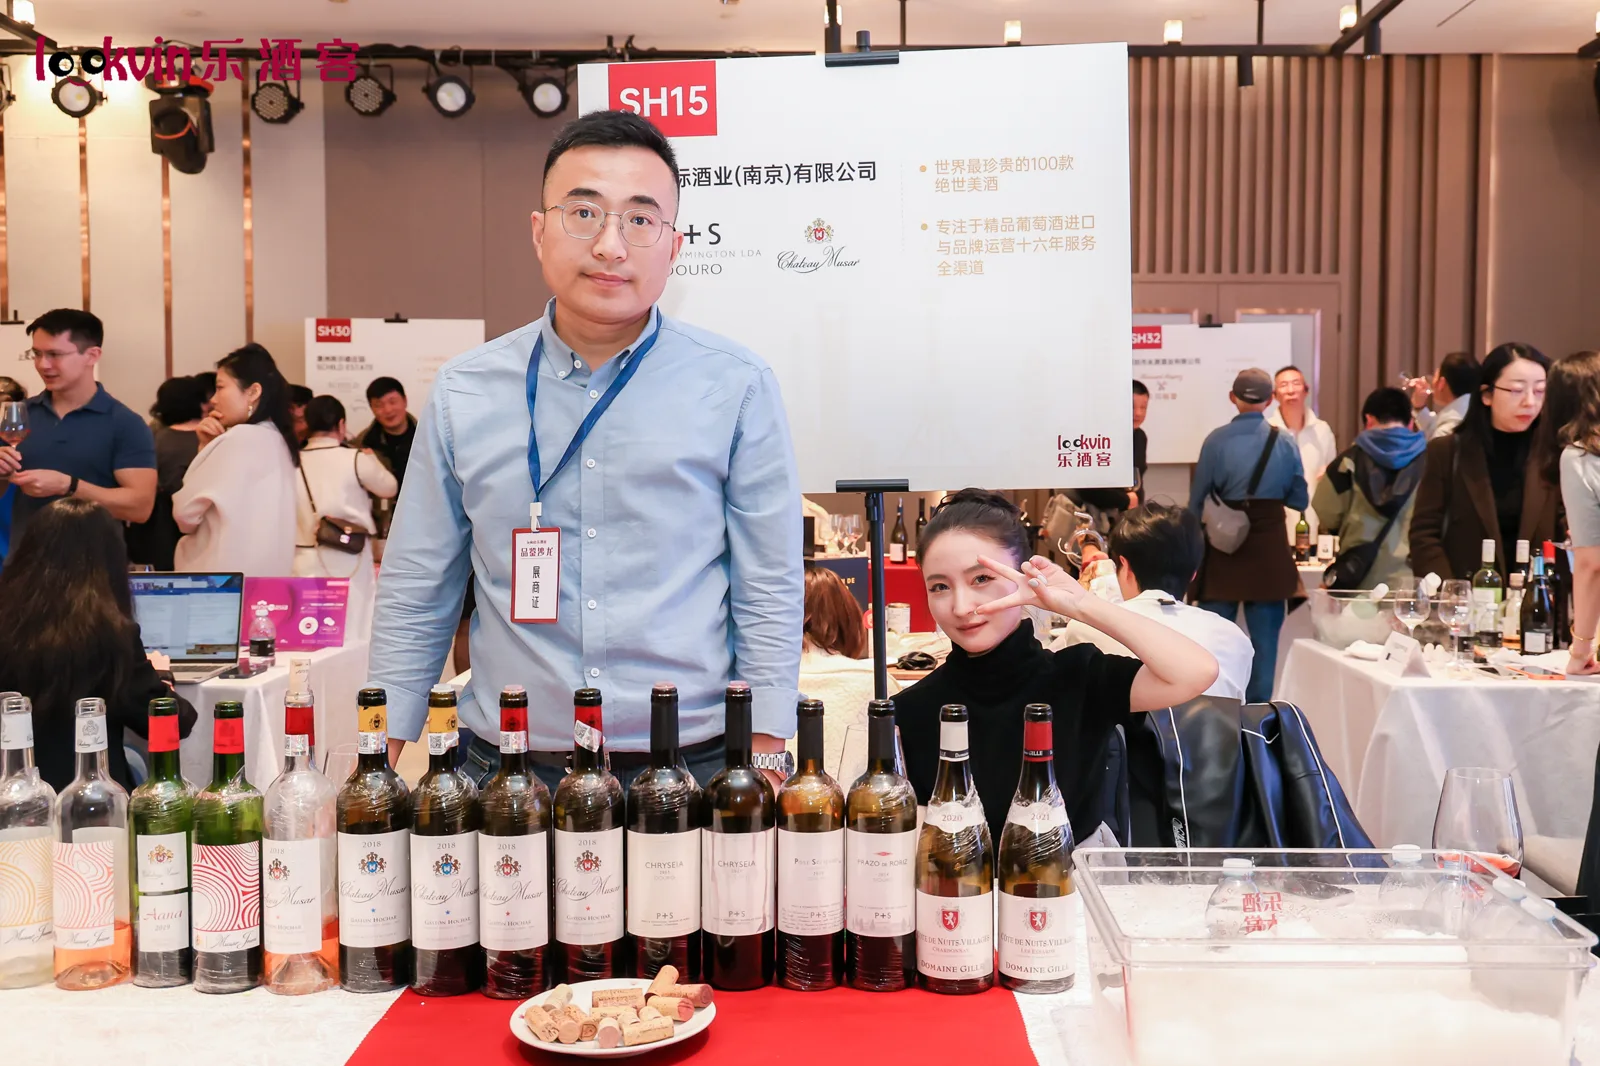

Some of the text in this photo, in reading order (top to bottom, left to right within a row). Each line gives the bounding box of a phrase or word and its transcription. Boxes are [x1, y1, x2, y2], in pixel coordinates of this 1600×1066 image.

[619, 85, 709, 117] SH15
[934, 154, 1074, 176] 世界最珍贵的100款
[934, 176, 999, 194] 绝世美酒
[936, 214, 1096, 235] 专注于精品葡萄酒进口
[741, 249, 762, 258] LDA
[936, 235, 1097, 256] 与品牌运营十六年服务
[777, 245, 861, 274] Chateau Musar
[937, 260, 985, 277] 全渠道
[317, 326, 350, 338] SH30
[1132, 333, 1161, 344] SH32
[1058, 434, 1111, 451] lookvin
[1058, 452, 1112, 467] 乐酒客
[531, 565, 541, 609] 展商证
[941, 814, 963, 822] 2020
[1030, 812, 1051, 821] 2021
[437, 842, 456, 850] 2018
[578, 839, 597, 847] 2018
[644, 861, 684, 869] CHRYSEIA
[718, 860, 756, 868] CHRYSEIA
[889, 858, 908, 867] RORIZ
[279, 885, 315, 905] Musar
[340, 875, 408, 904] Chateau Musar
[510, 880, 544, 901] Musar
[557, 874, 621, 902] Chateau Musar
[920, 960, 957, 973] DOMAINE
[1005, 961, 1045, 974] DOMAINE
